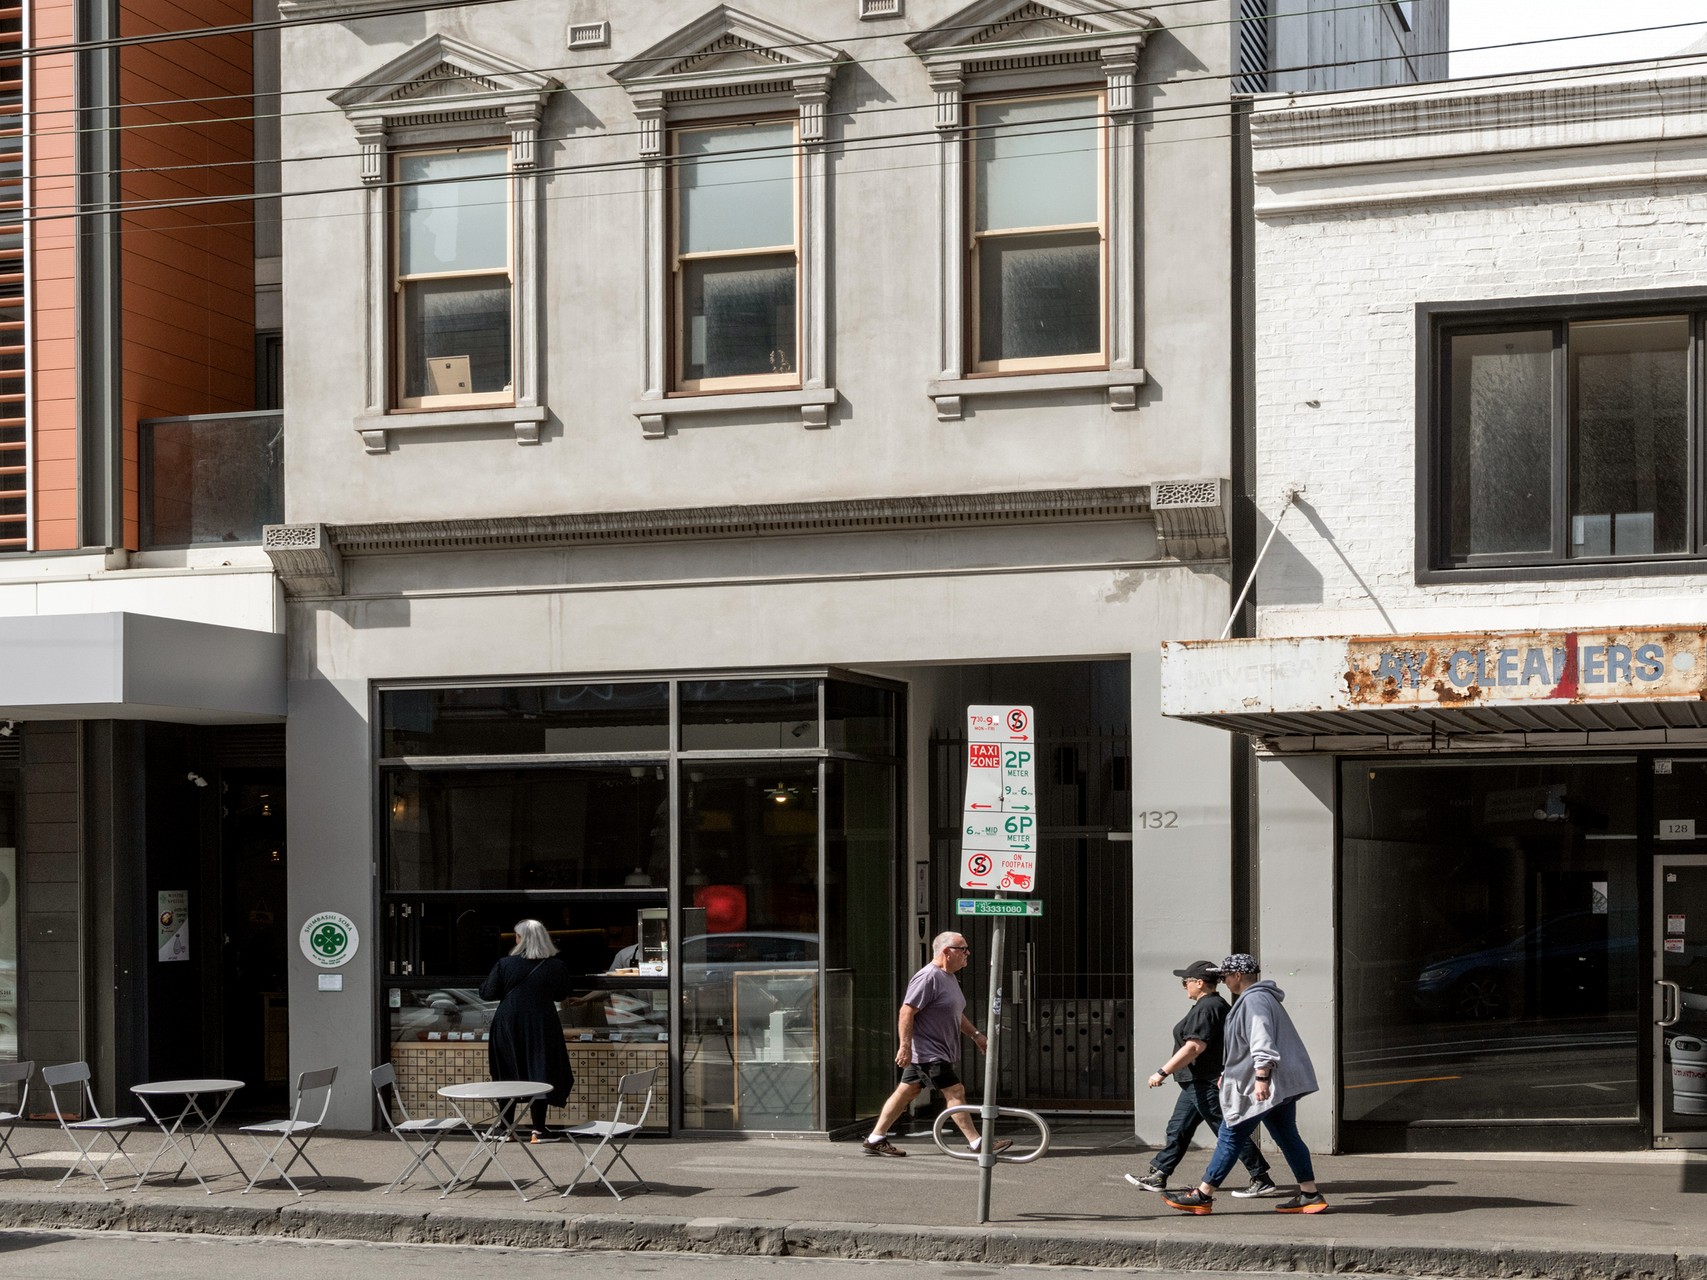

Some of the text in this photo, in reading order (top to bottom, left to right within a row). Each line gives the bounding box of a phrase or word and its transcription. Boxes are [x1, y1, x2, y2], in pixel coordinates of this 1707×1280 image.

[972, 745, 998, 756] TAXI
[970, 757, 1000, 767] ZONE
[1005, 751, 1031, 769] 2P
[1004, 816, 1033, 833] 6P
[1138, 810, 1178, 829] 132
[1668, 824, 1688, 833] 128
[1001, 860, 1033, 869] FOOTPATH
[304, 914, 354, 933] SHIMBASHI SOBA
